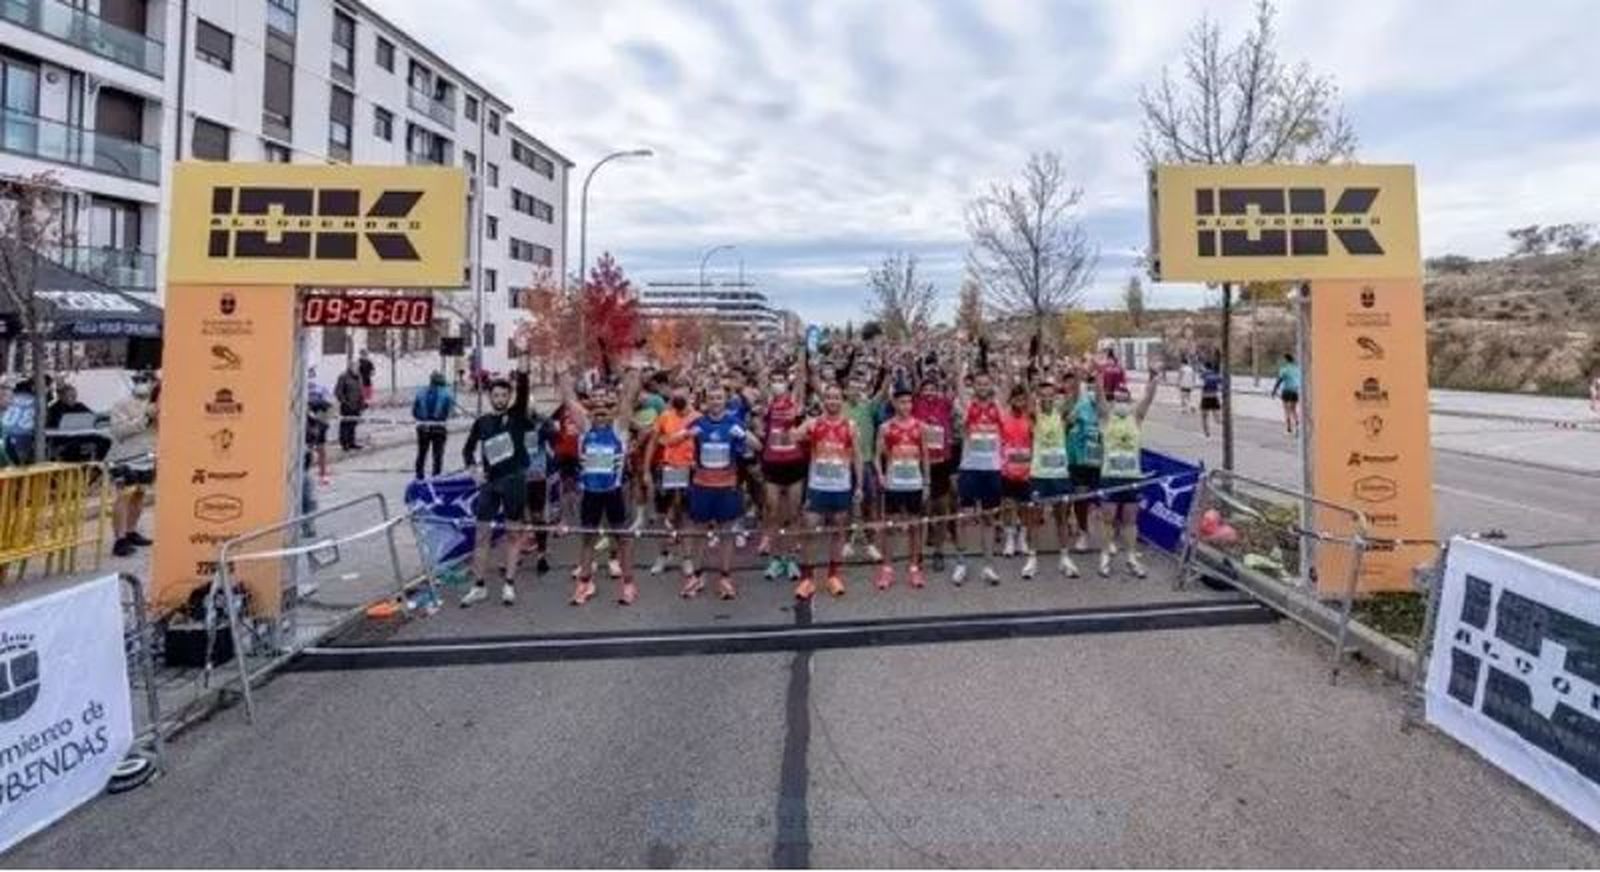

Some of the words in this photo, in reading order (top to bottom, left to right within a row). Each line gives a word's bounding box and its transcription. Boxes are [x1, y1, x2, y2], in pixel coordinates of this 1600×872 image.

[209, 186, 425, 261] 10K
[1195, 187, 1386, 257] 10K
[306, 298, 429, 325] 09:26:00
[82, 699, 105, 725] de
[0, 725, 108, 804] BENDAS
